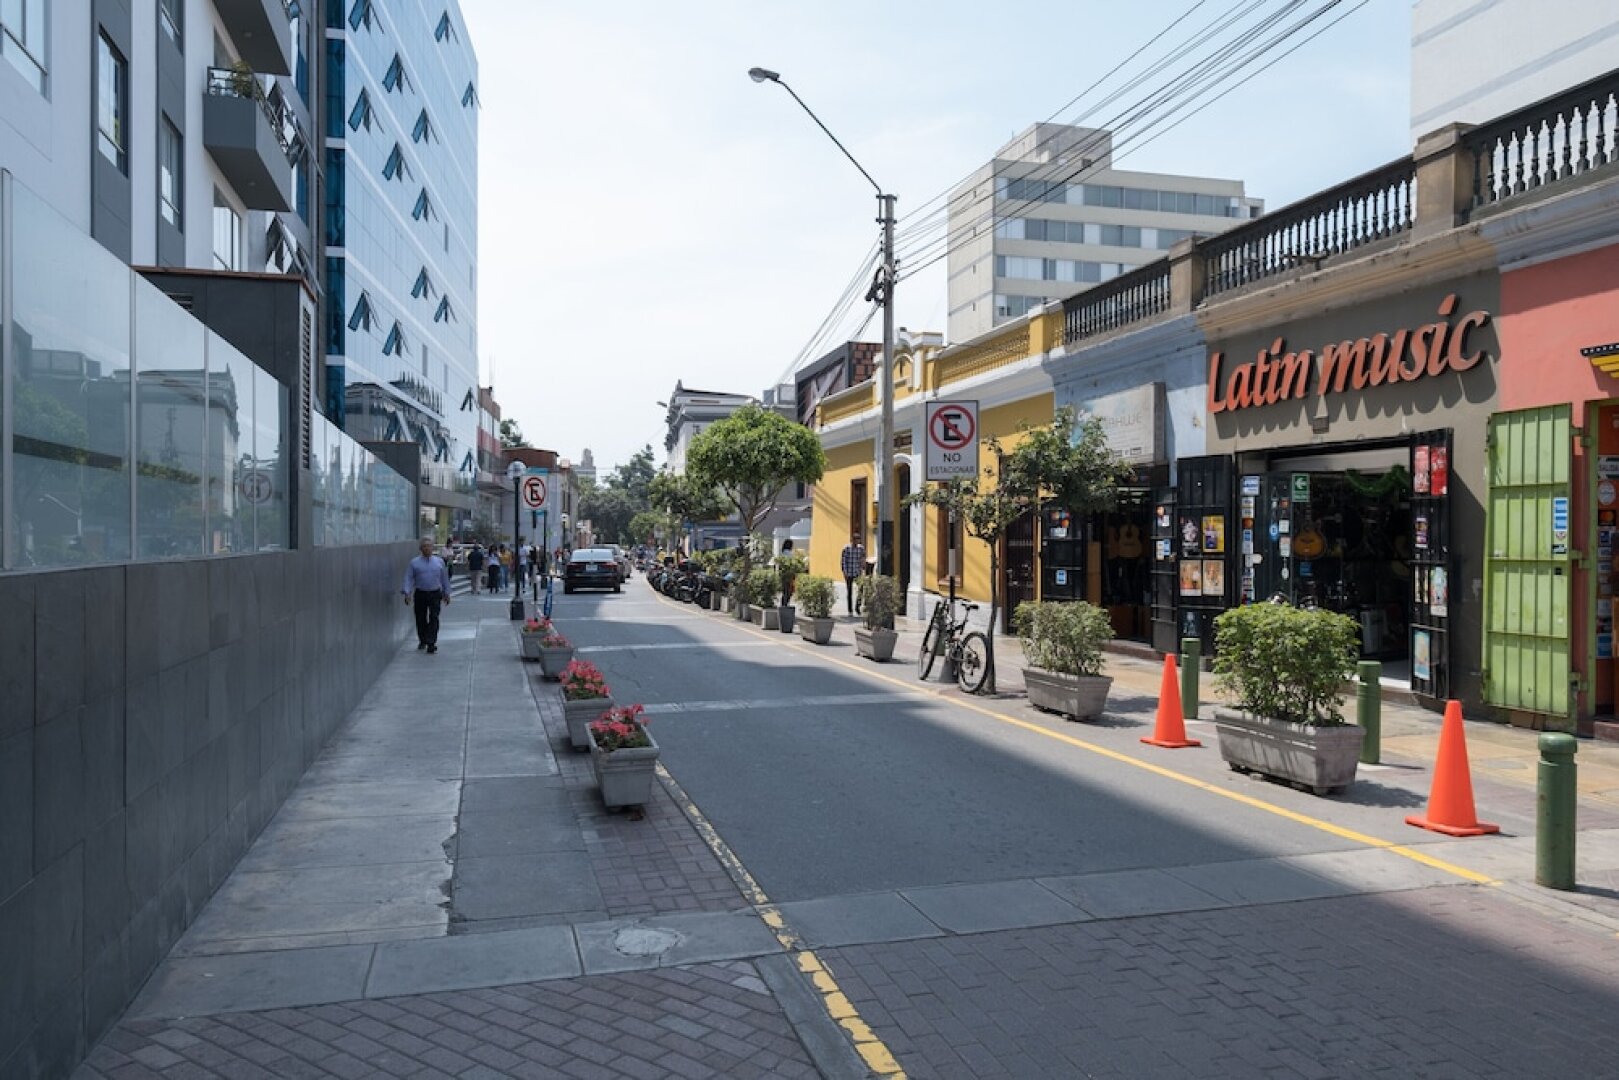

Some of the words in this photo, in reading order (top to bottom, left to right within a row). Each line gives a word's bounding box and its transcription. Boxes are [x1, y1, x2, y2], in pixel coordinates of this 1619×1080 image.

[1208, 336, 1313, 414] Latin
[1317, 293, 1489, 396] music
[943, 453, 961, 462] NO
[930, 466, 974, 474] ESTACIONAR
